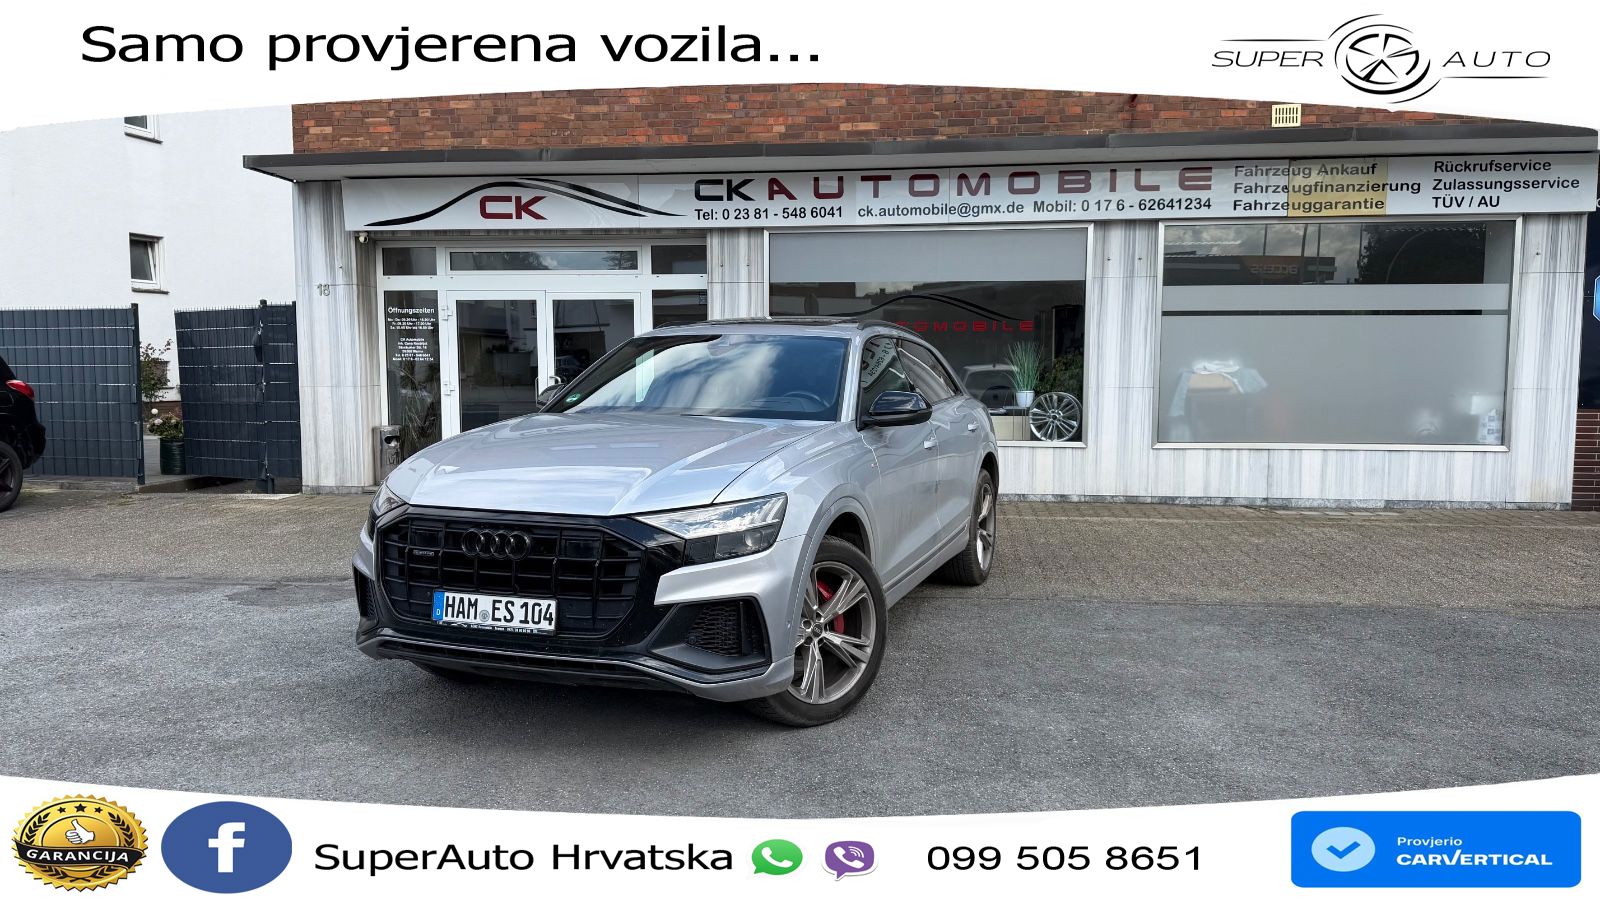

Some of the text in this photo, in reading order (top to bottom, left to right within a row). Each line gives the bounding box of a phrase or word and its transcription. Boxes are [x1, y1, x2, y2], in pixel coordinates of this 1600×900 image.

[1234, 163, 1377, 179] Fahrzeug Ankauf
[1434, 160, 1552, 173] Rückrufservice
[693, 166, 1213, 201] CK AUTOMOBILE
[1233, 180, 1422, 195] Fahrzeugfinanzierung
[1432, 176, 1580, 192] Zulassungsservice
[479, 195, 548, 220] CK
[857, 202, 1024, 218] ck.automobile@gmx.de
[1033, 200, 1077, 213] Mobil:
[1081, 200, 1089, 212] 0
[1138, 197, 1212, 211] 62641234
[1233, 197, 1385, 213] Fahrzeuggarantie
[1432, 194, 1464, 209] TÜV
[1477, 196, 1500, 208] AU
[694, 208, 718, 221] Tel:
[722, 208, 730, 220] 0
[733, 208, 750, 220] 23
[753, 208, 769, 219] 81
[782, 207, 807, 219] 548
[810, 206, 842, 219] 6041
[317, 283, 330, 296] 18
[445, 595, 478, 620] HAM
[491, 600, 514, 623] ES
[519, 601, 554, 626] 104
